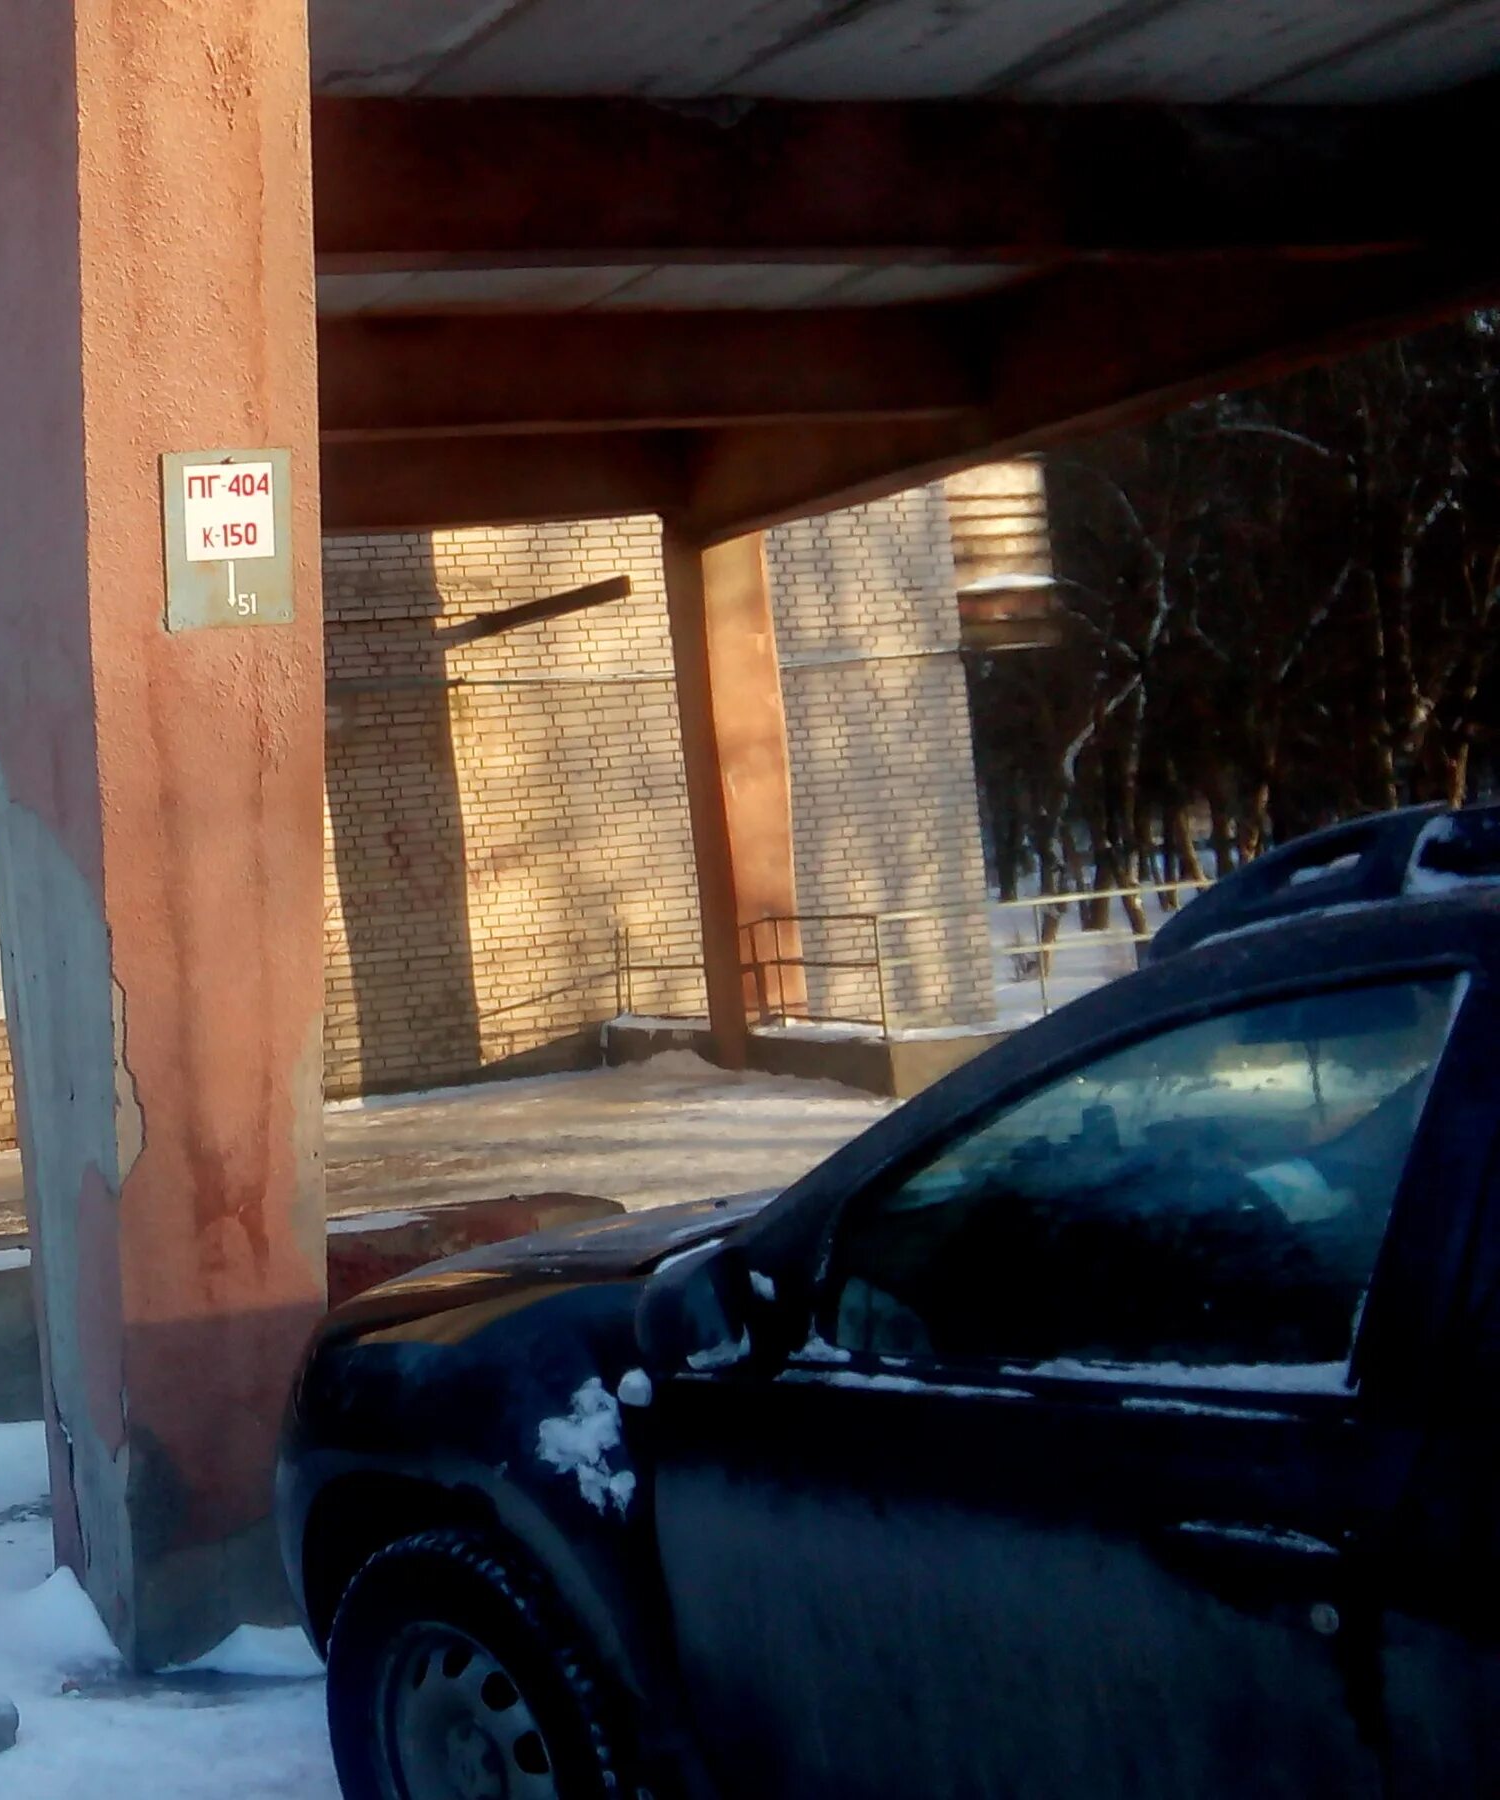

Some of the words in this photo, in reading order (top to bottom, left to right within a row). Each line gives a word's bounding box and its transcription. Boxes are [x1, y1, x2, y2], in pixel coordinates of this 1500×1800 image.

[187, 472, 269, 499] ПГ-404
[202, 522, 258, 548] К-150
[237, 593, 257, 615] 51
